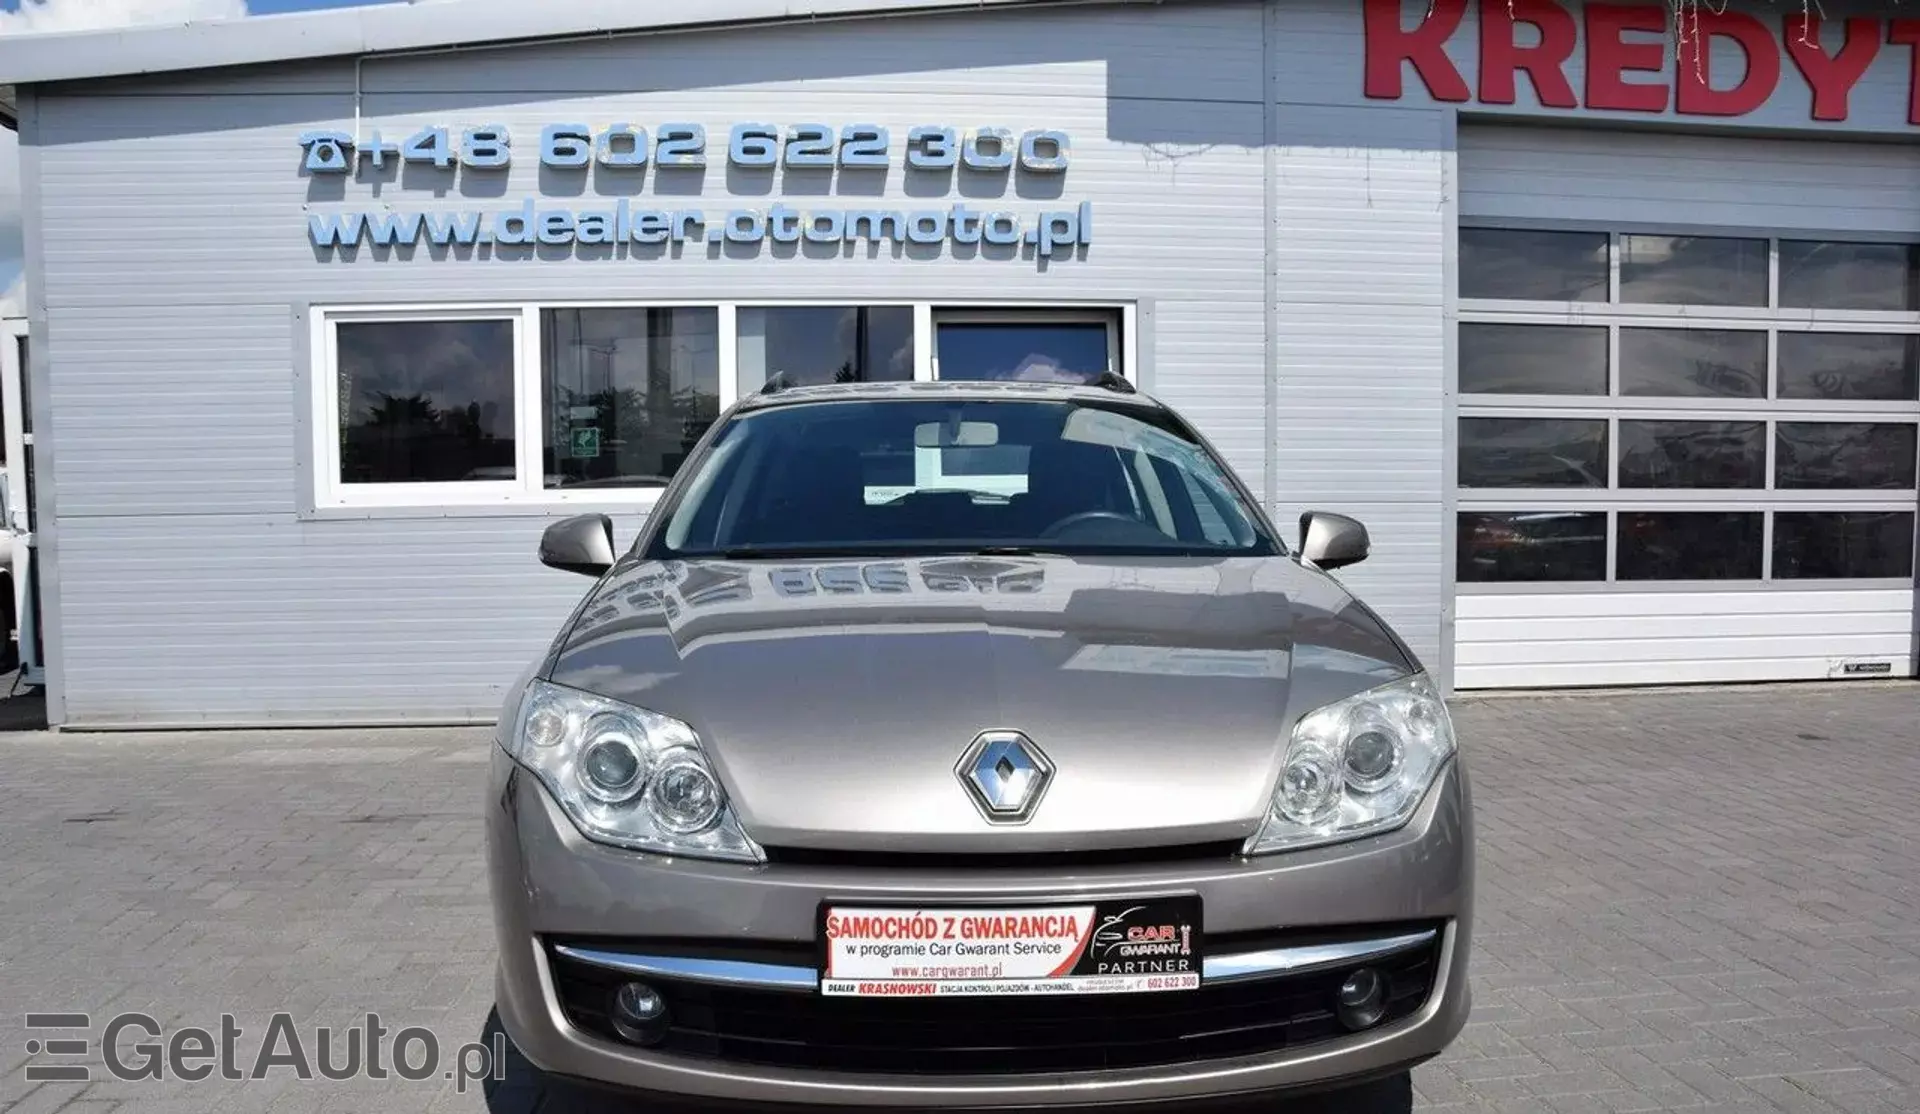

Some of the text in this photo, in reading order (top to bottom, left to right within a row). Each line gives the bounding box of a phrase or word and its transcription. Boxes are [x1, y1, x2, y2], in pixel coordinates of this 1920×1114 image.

[357, 122, 1072, 172] +48 602 622 300
[307, 197, 1092, 256] www.dealer.otomoto.pl
[826, 910, 1078, 942] SAMOCHÓD Z GWARANCJĄ
[1127, 925, 1176, 941] CAR
[846, 940, 1061, 957] w programie Car Gwarant Service
[1120, 943, 1181, 956] GWARANT
[891, 962, 1002, 978] www.cargwarant.pl
[1098, 959, 1189, 974] PARTNER
[828, 984, 856, 993] DEALER
[858, 983, 938, 994] KRASNOWSKI
[940, 985, 963, 993] STACJA
[1147, 976, 1196, 989] 602 622 300
